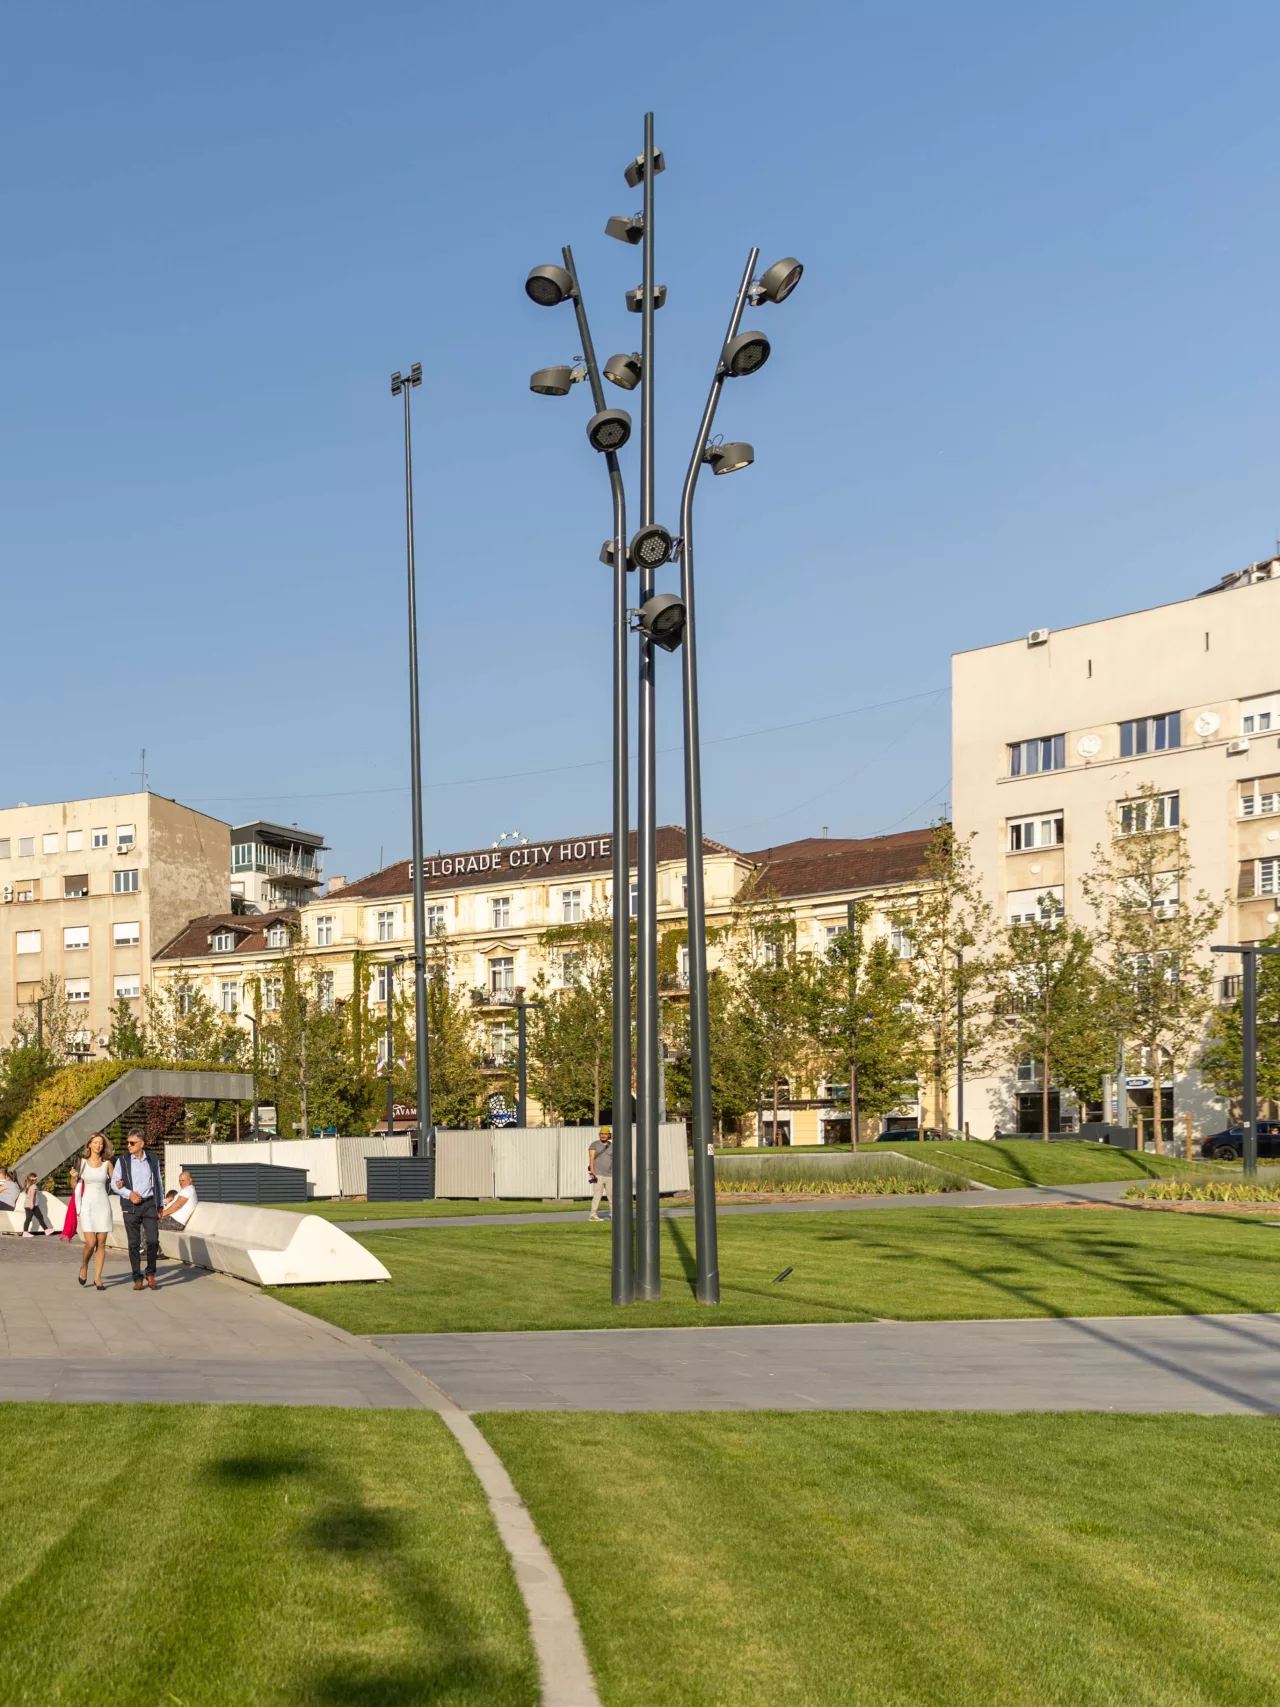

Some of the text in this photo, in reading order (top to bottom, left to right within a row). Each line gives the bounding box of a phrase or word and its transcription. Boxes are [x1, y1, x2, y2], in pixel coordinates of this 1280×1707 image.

[408, 838, 612, 879] BELGRADE CITY HOTE
